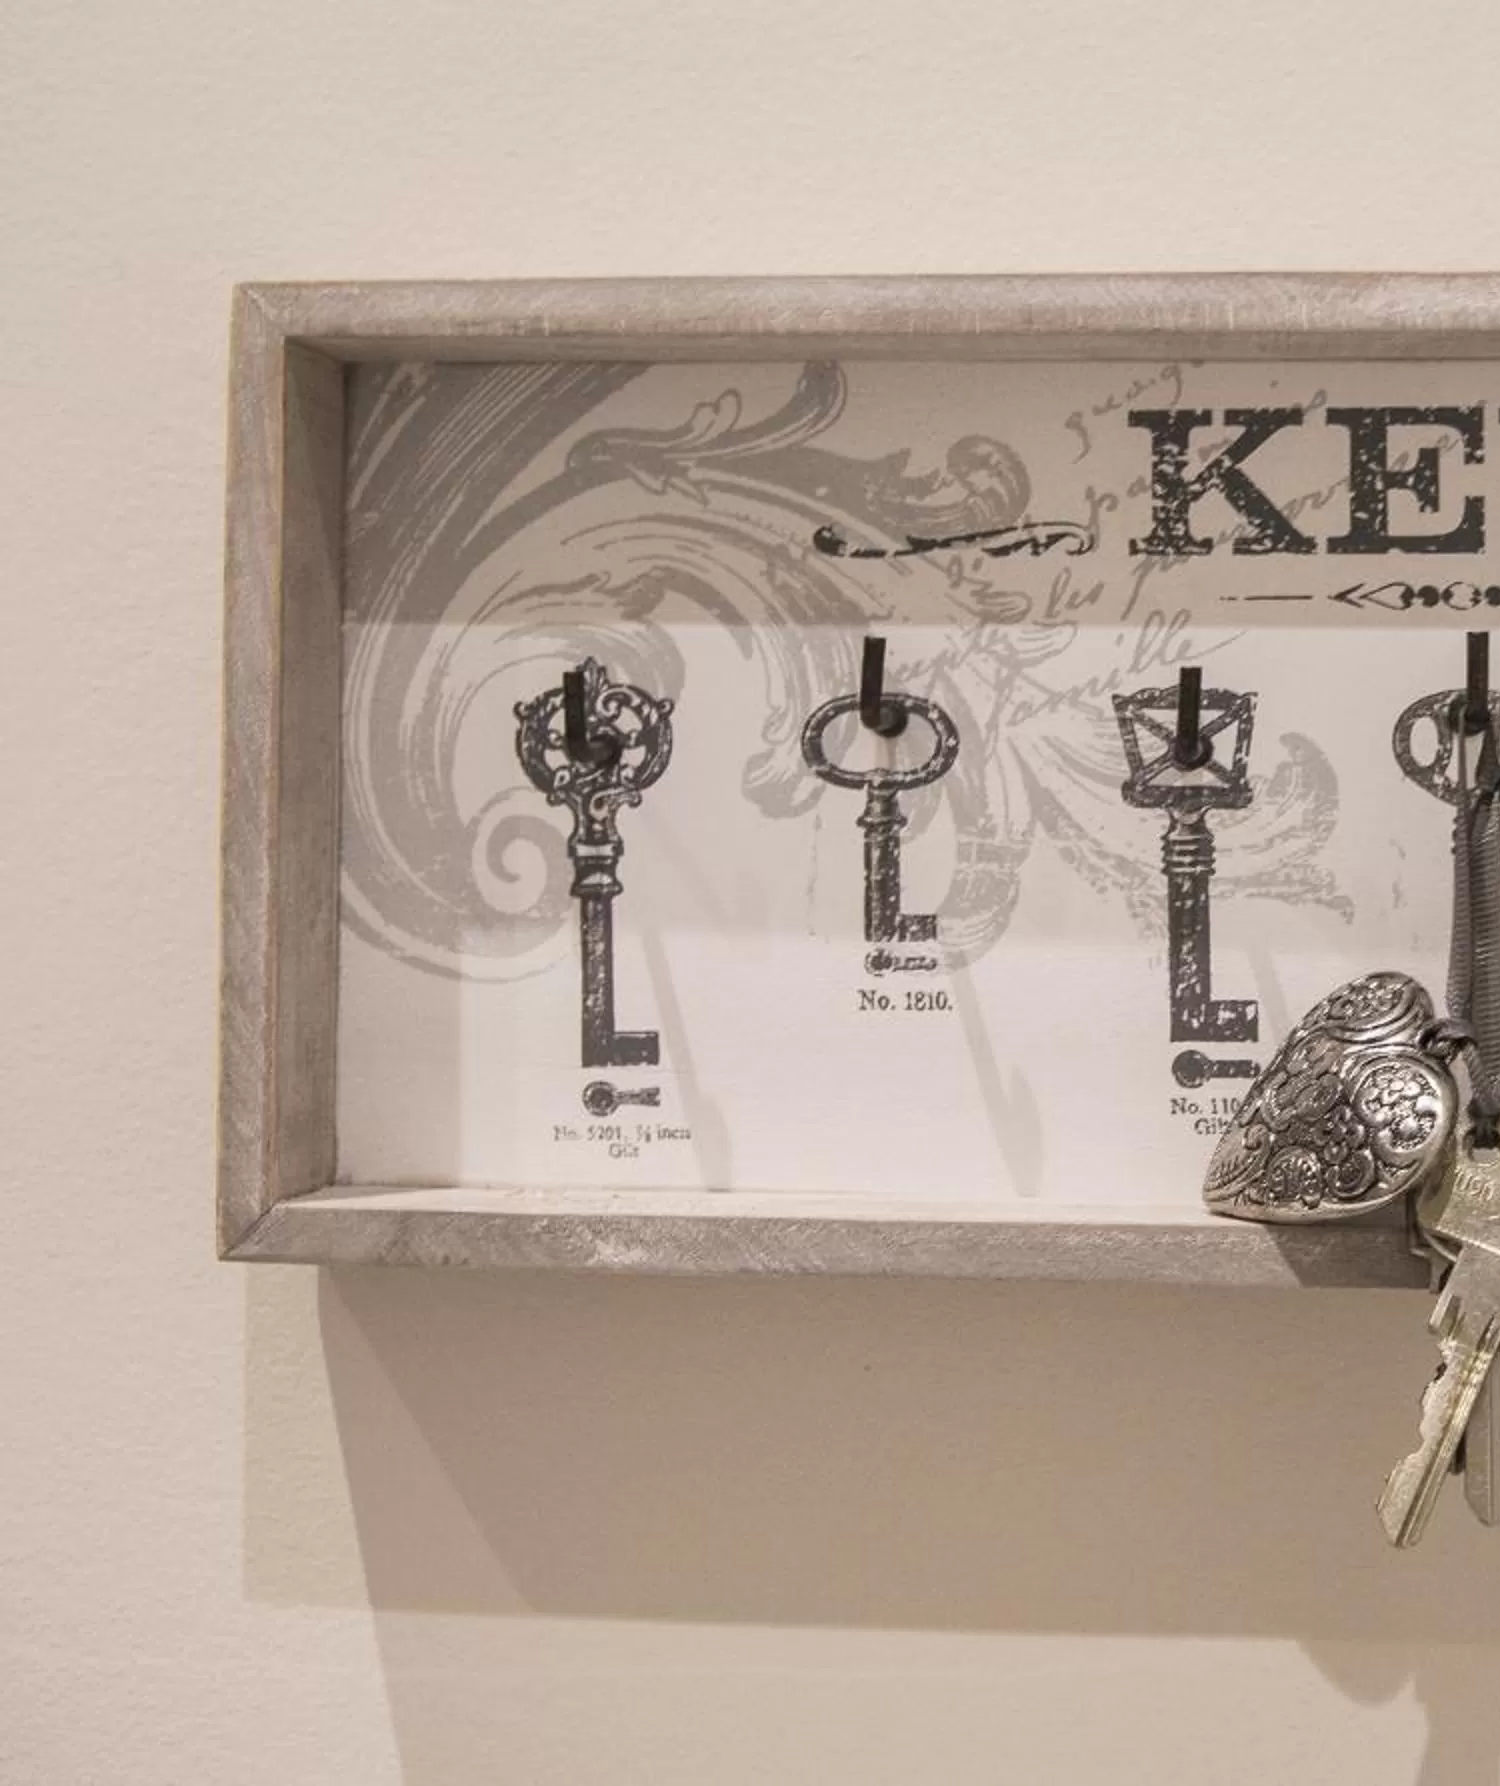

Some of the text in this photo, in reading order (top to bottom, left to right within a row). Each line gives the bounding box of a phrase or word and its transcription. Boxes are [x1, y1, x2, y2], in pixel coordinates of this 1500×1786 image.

[856, 988, 953, 1011] No. 1810.
[1169, 1097, 1203, 1115] No.
